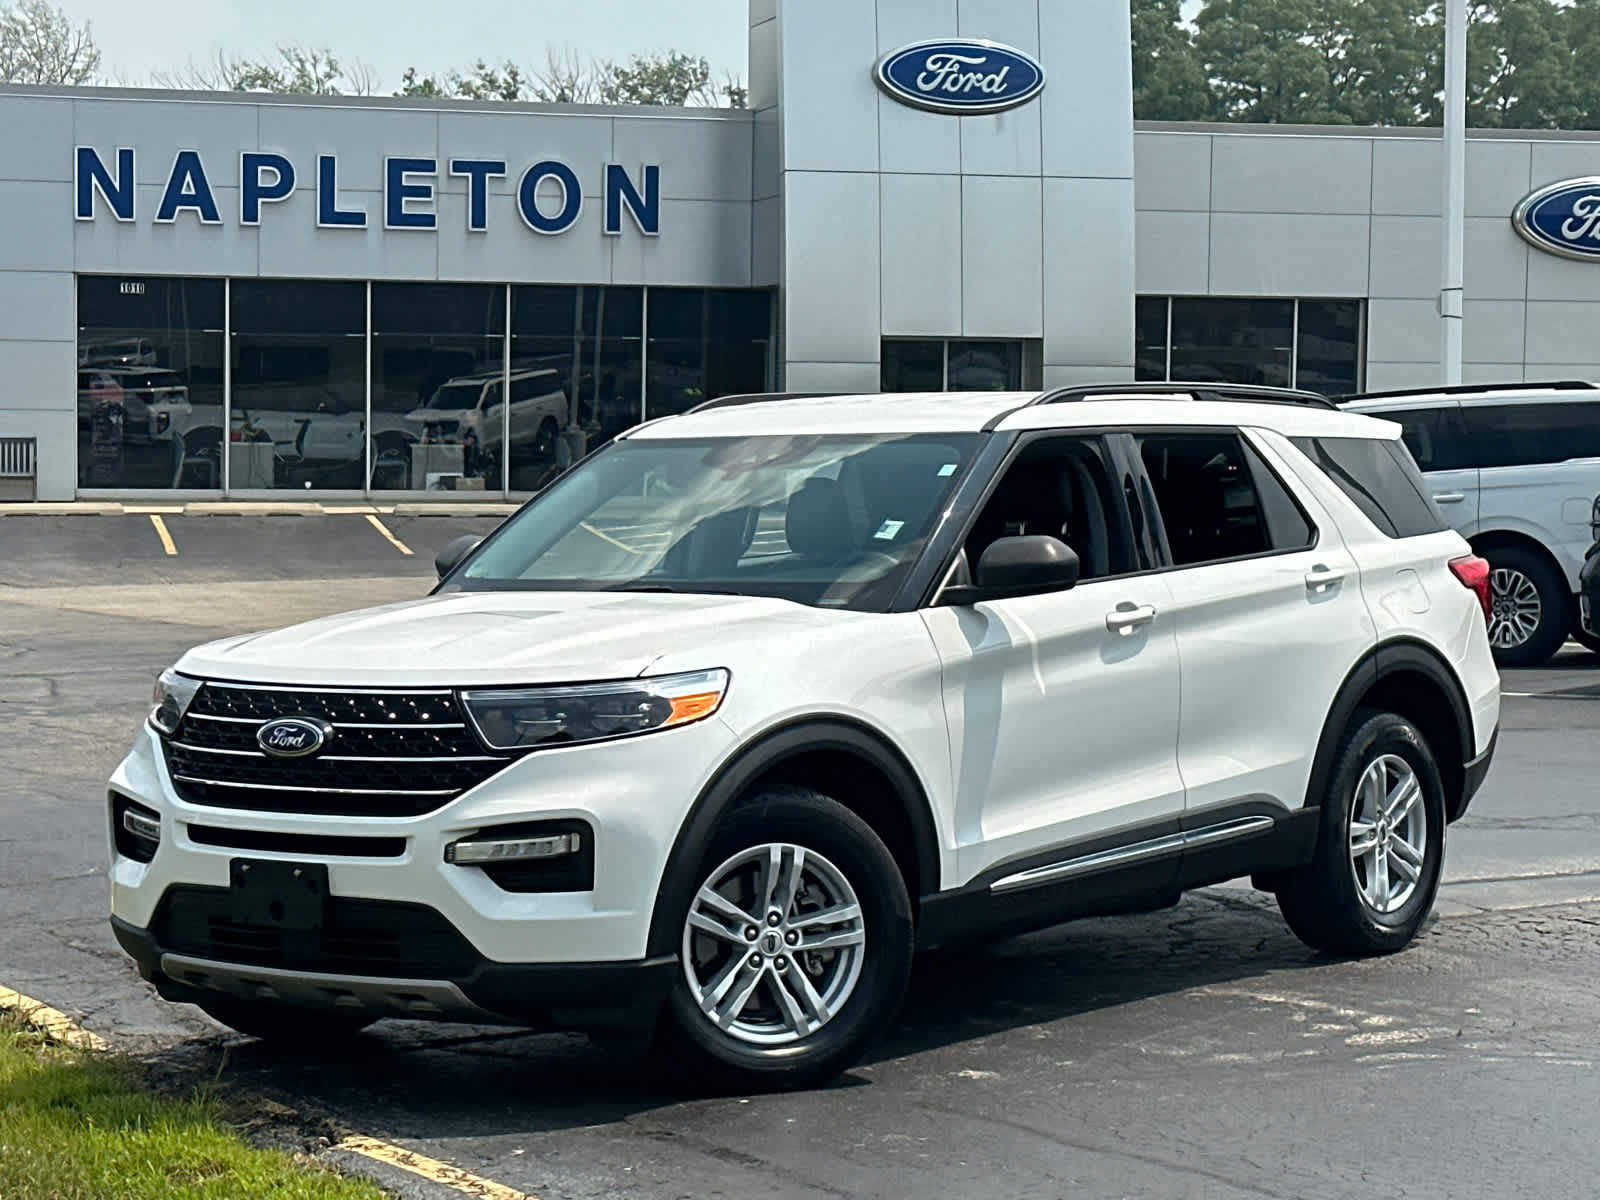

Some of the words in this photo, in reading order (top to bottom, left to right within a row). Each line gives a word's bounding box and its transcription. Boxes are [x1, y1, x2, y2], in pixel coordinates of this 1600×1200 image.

[916, 53, 1010, 93] Ford
[74, 145, 661, 236] NAPLETON
[268, 726, 306, 748] Ford
